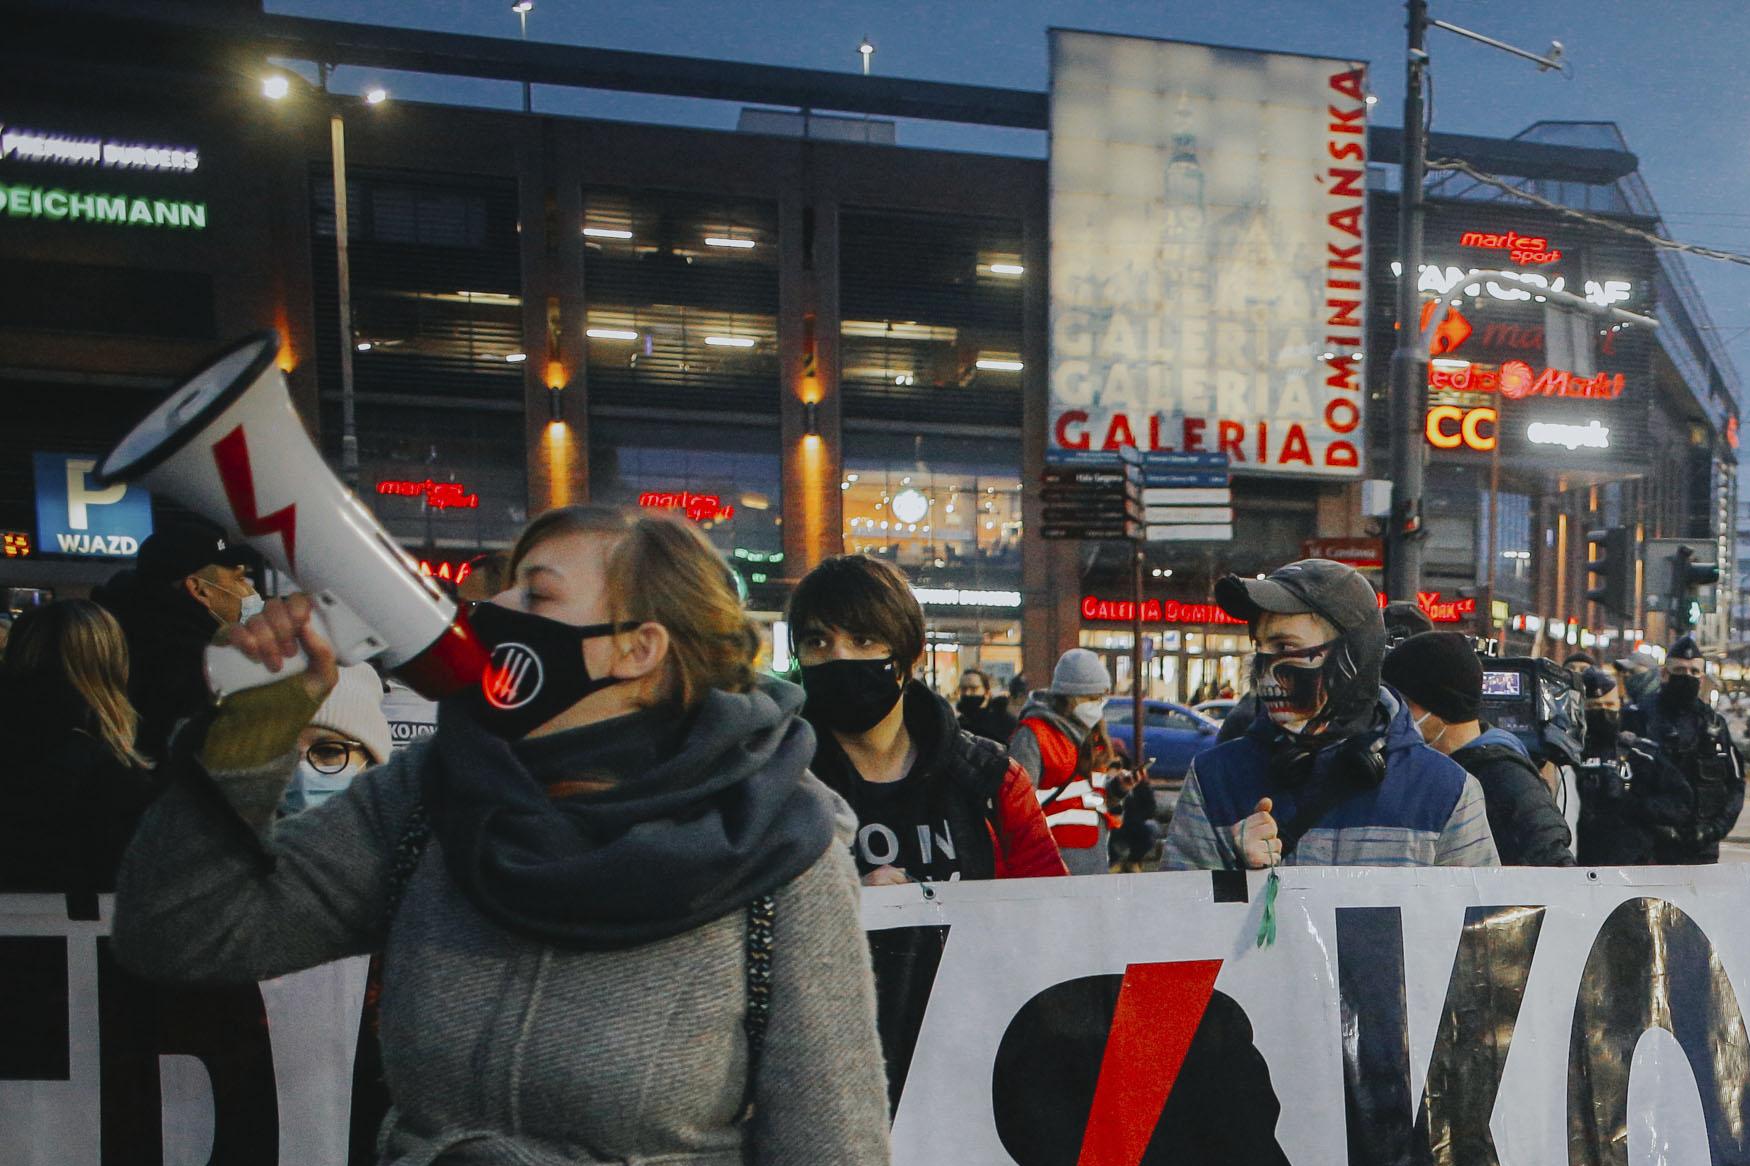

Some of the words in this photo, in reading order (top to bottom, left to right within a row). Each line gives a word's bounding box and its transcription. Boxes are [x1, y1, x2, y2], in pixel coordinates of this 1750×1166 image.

[1460, 231, 1548, 251] martes
[1510, 249, 1561, 266] sport
[1428, 363, 1500, 393] edia
[1532, 368, 1626, 399] Markt
[1055, 409, 1313, 468] GALERIA
[66, 458, 127, 530] P
[57, 533, 139, 555] WJAZD
